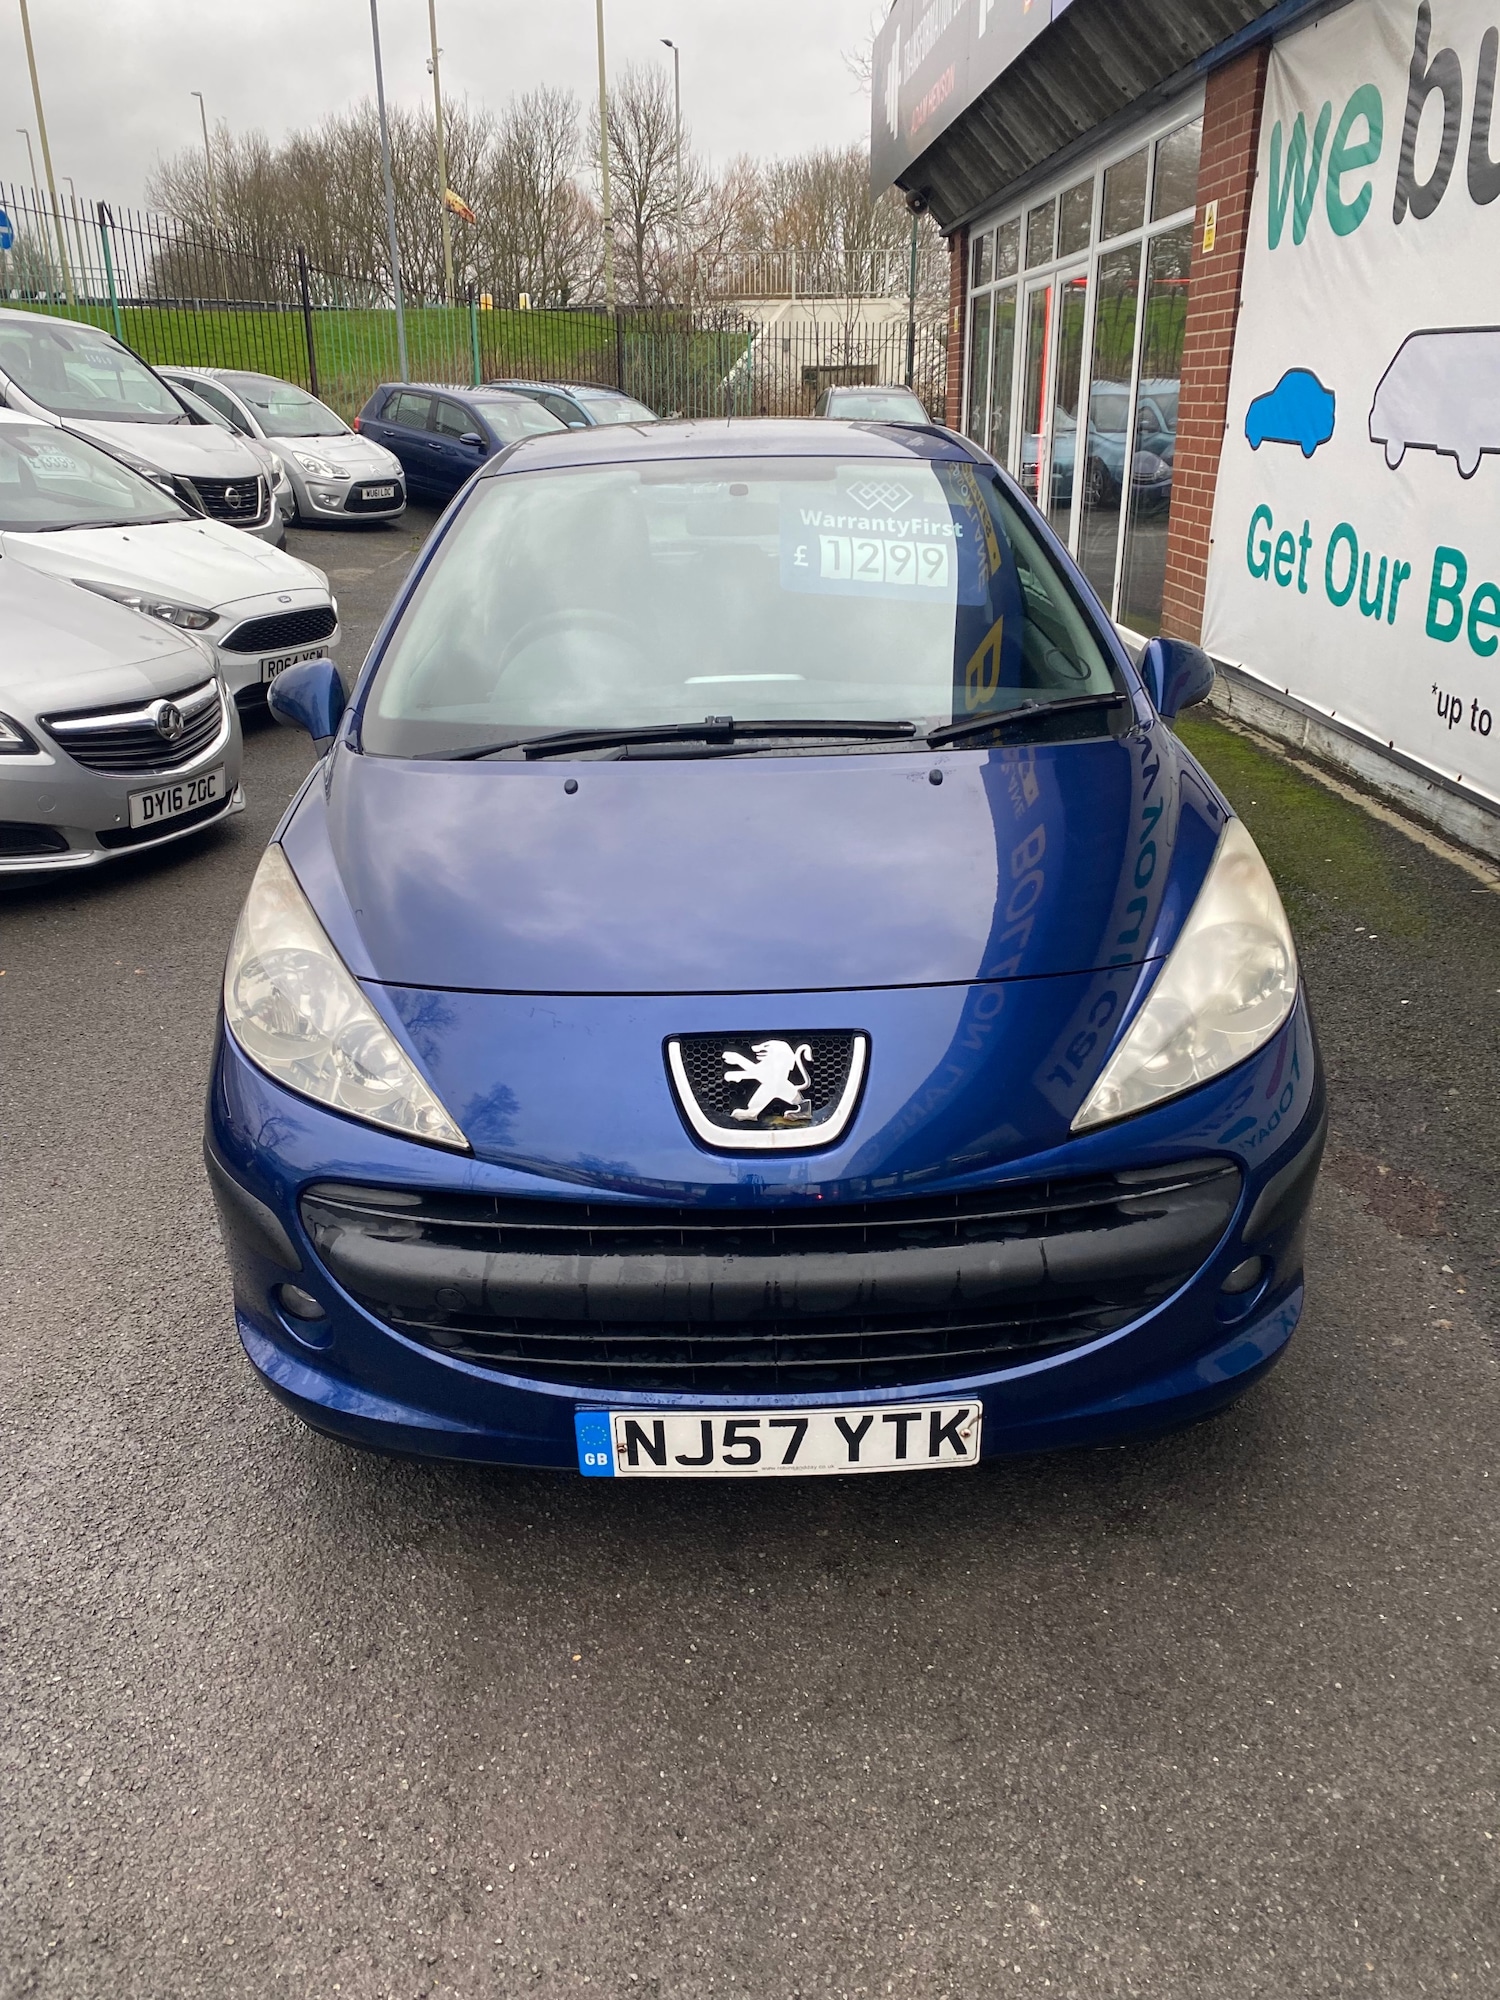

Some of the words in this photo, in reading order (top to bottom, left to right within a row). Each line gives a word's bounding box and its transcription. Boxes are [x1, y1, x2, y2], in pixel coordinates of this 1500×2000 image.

[1246, 503, 1312, 594] Get
[1324, 522, 1411, 625] Our
[1425, 545, 1500, 657] Be
[1470, 698, 1492, 736] to
[142, 787, 184, 821] DY16
[584, 1453, 608, 1466] GB
[624, 1417, 809, 1467] NJ57
[834, 1409, 970, 1463] YTK
